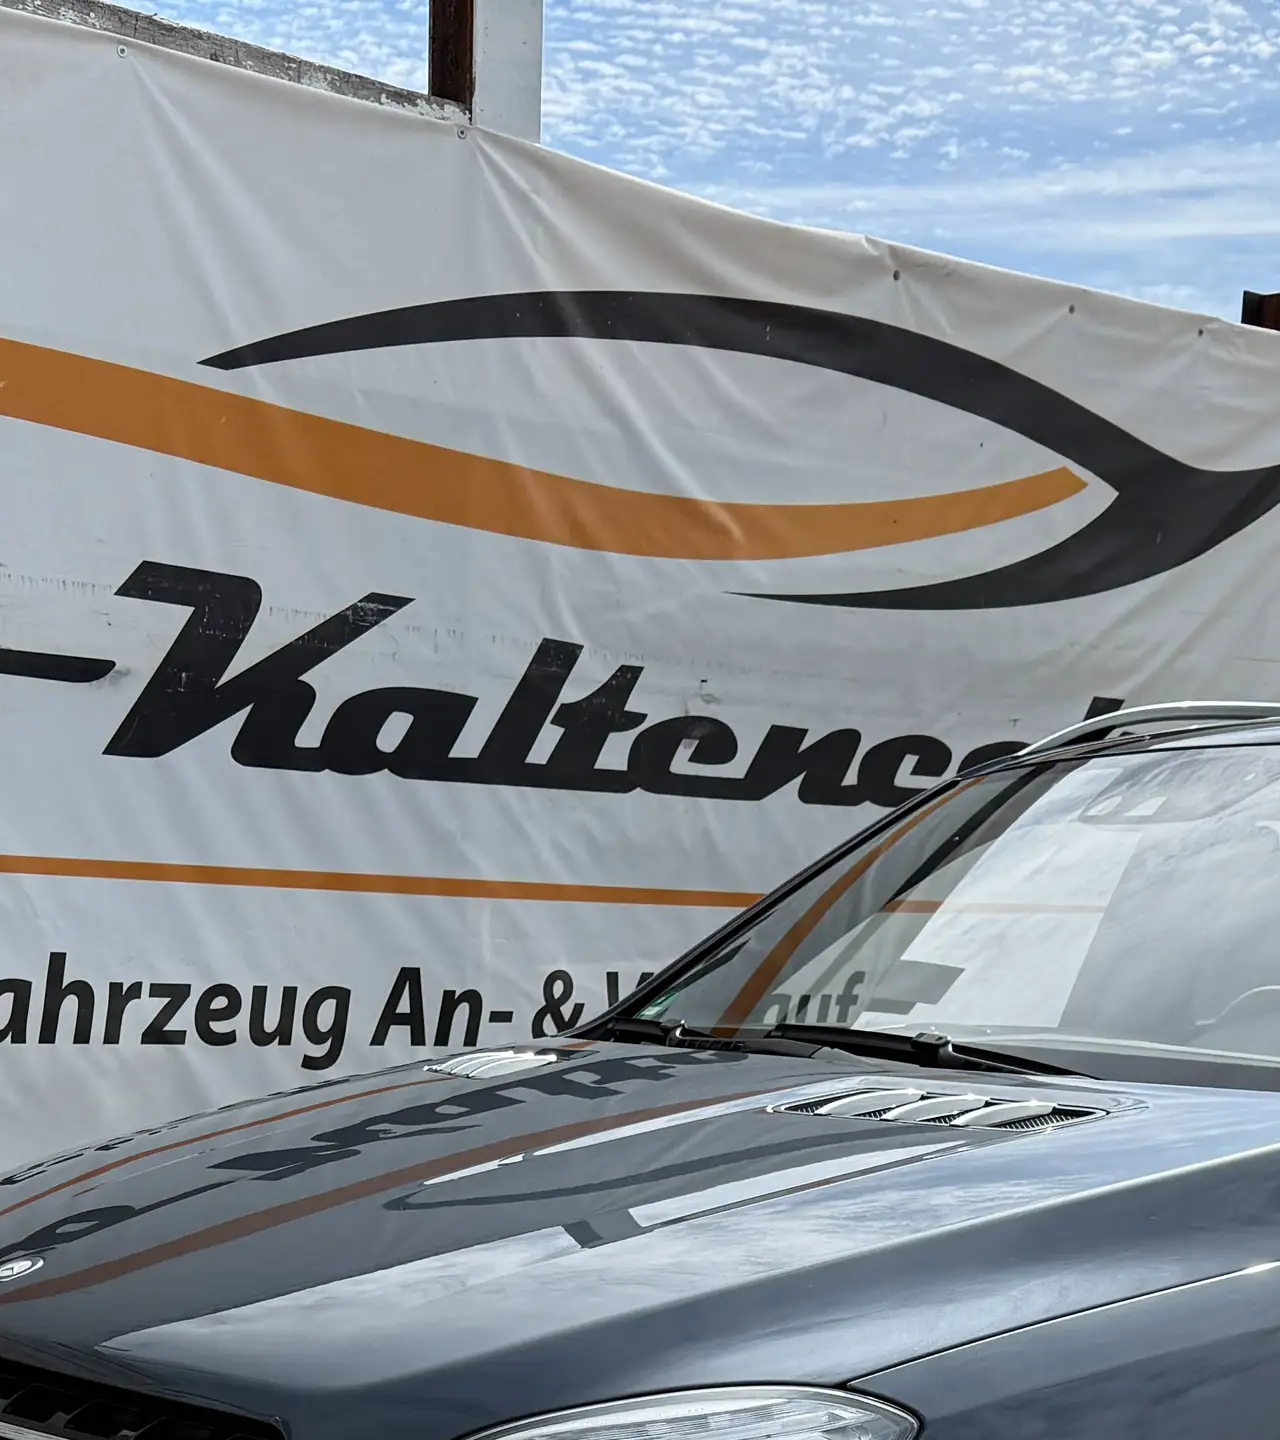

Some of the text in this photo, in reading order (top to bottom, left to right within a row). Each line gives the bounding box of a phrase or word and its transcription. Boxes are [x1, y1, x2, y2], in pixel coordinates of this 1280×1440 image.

[102, 560, 1125, 808] Kaltene
[370, 966, 514, 1048] An-
[532, 970, 600, 1042] &
